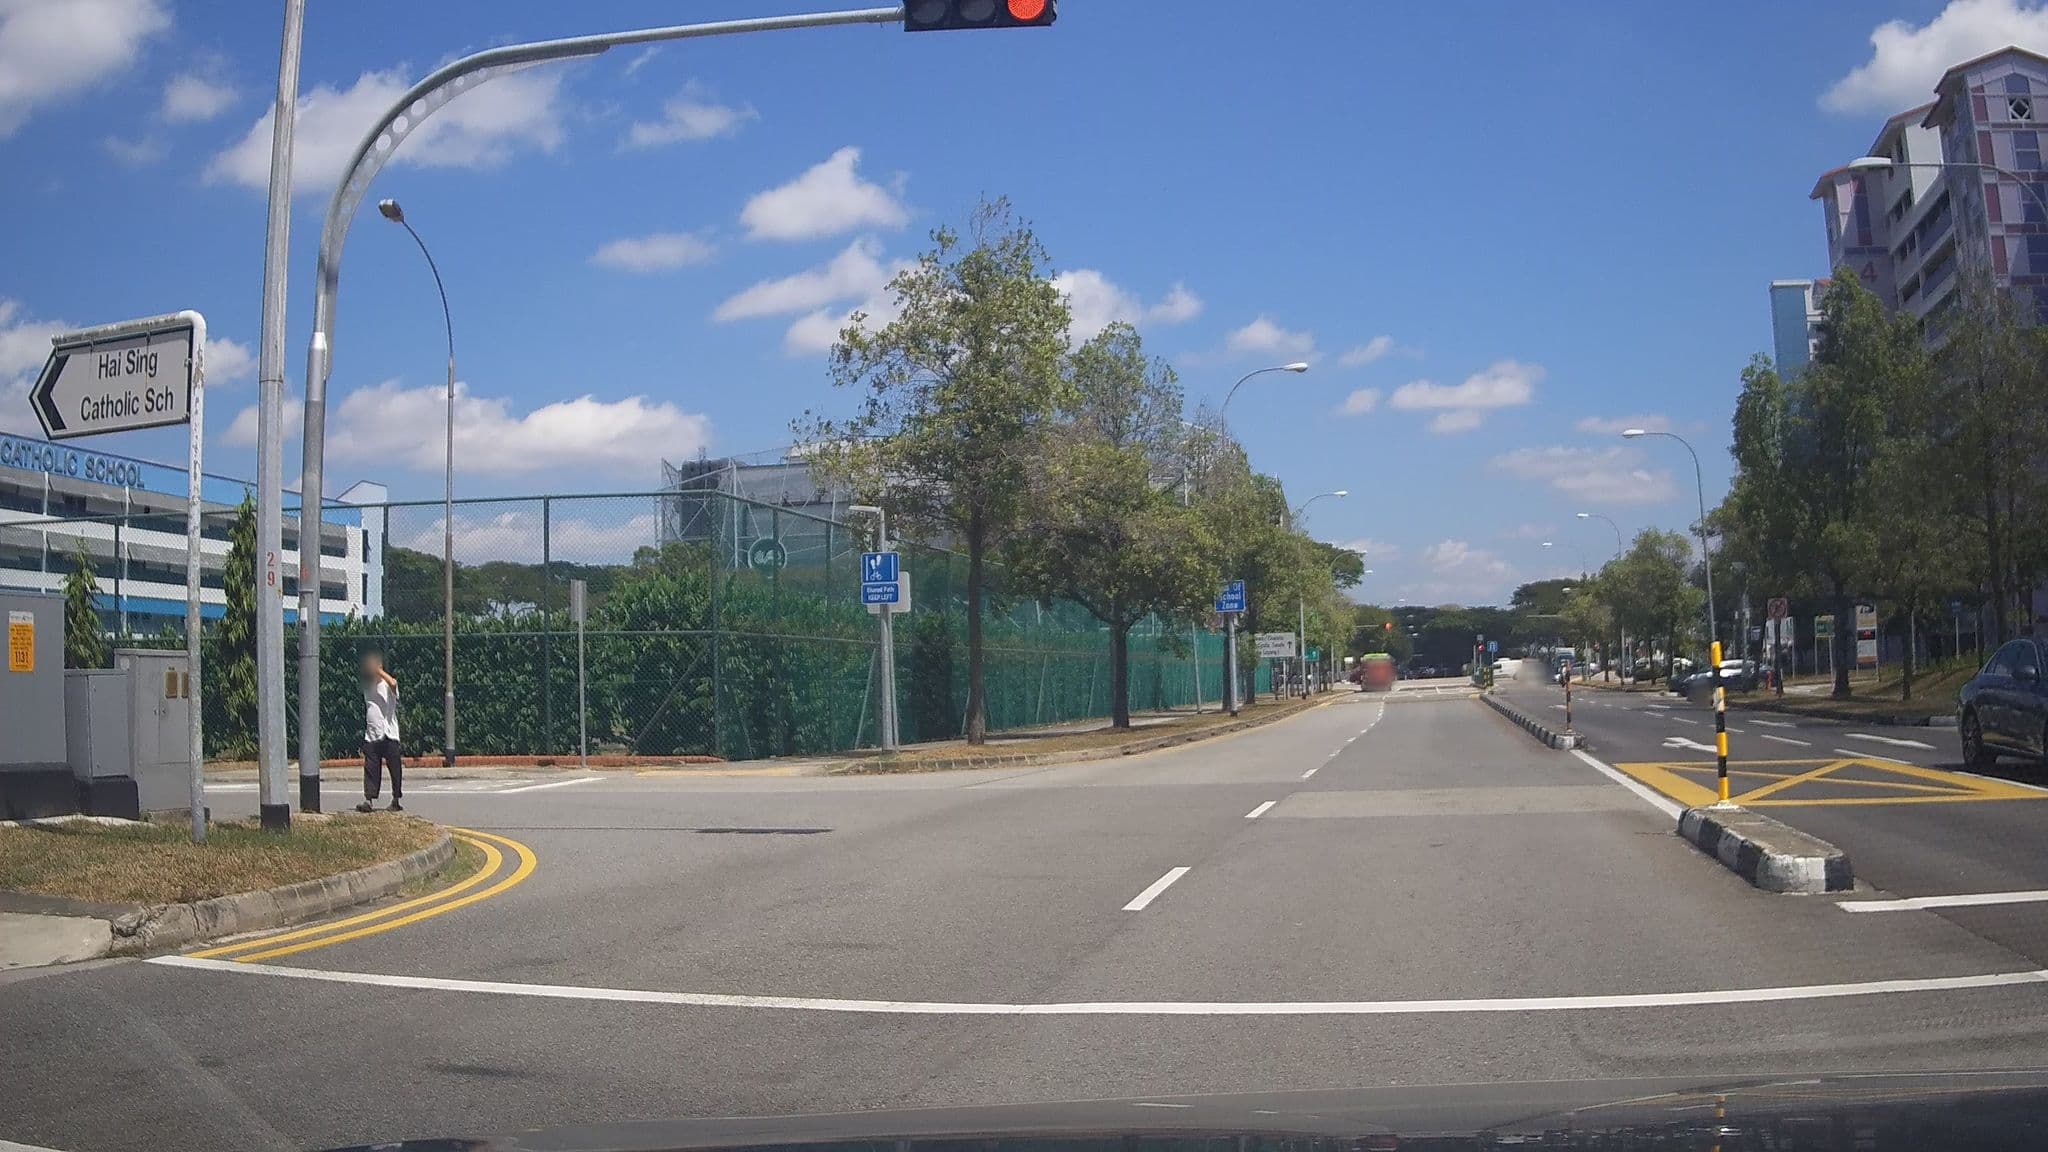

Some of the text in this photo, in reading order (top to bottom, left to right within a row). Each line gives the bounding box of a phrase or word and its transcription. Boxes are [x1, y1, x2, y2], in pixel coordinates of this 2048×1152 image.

[98, 349, 158, 380] Hai Sing
[80, 386, 173, 421] Catholic Sch
[0, 437, 145, 488] CATHOLIC SCHOOL
[1222, 601, 1238, 609] Zone
